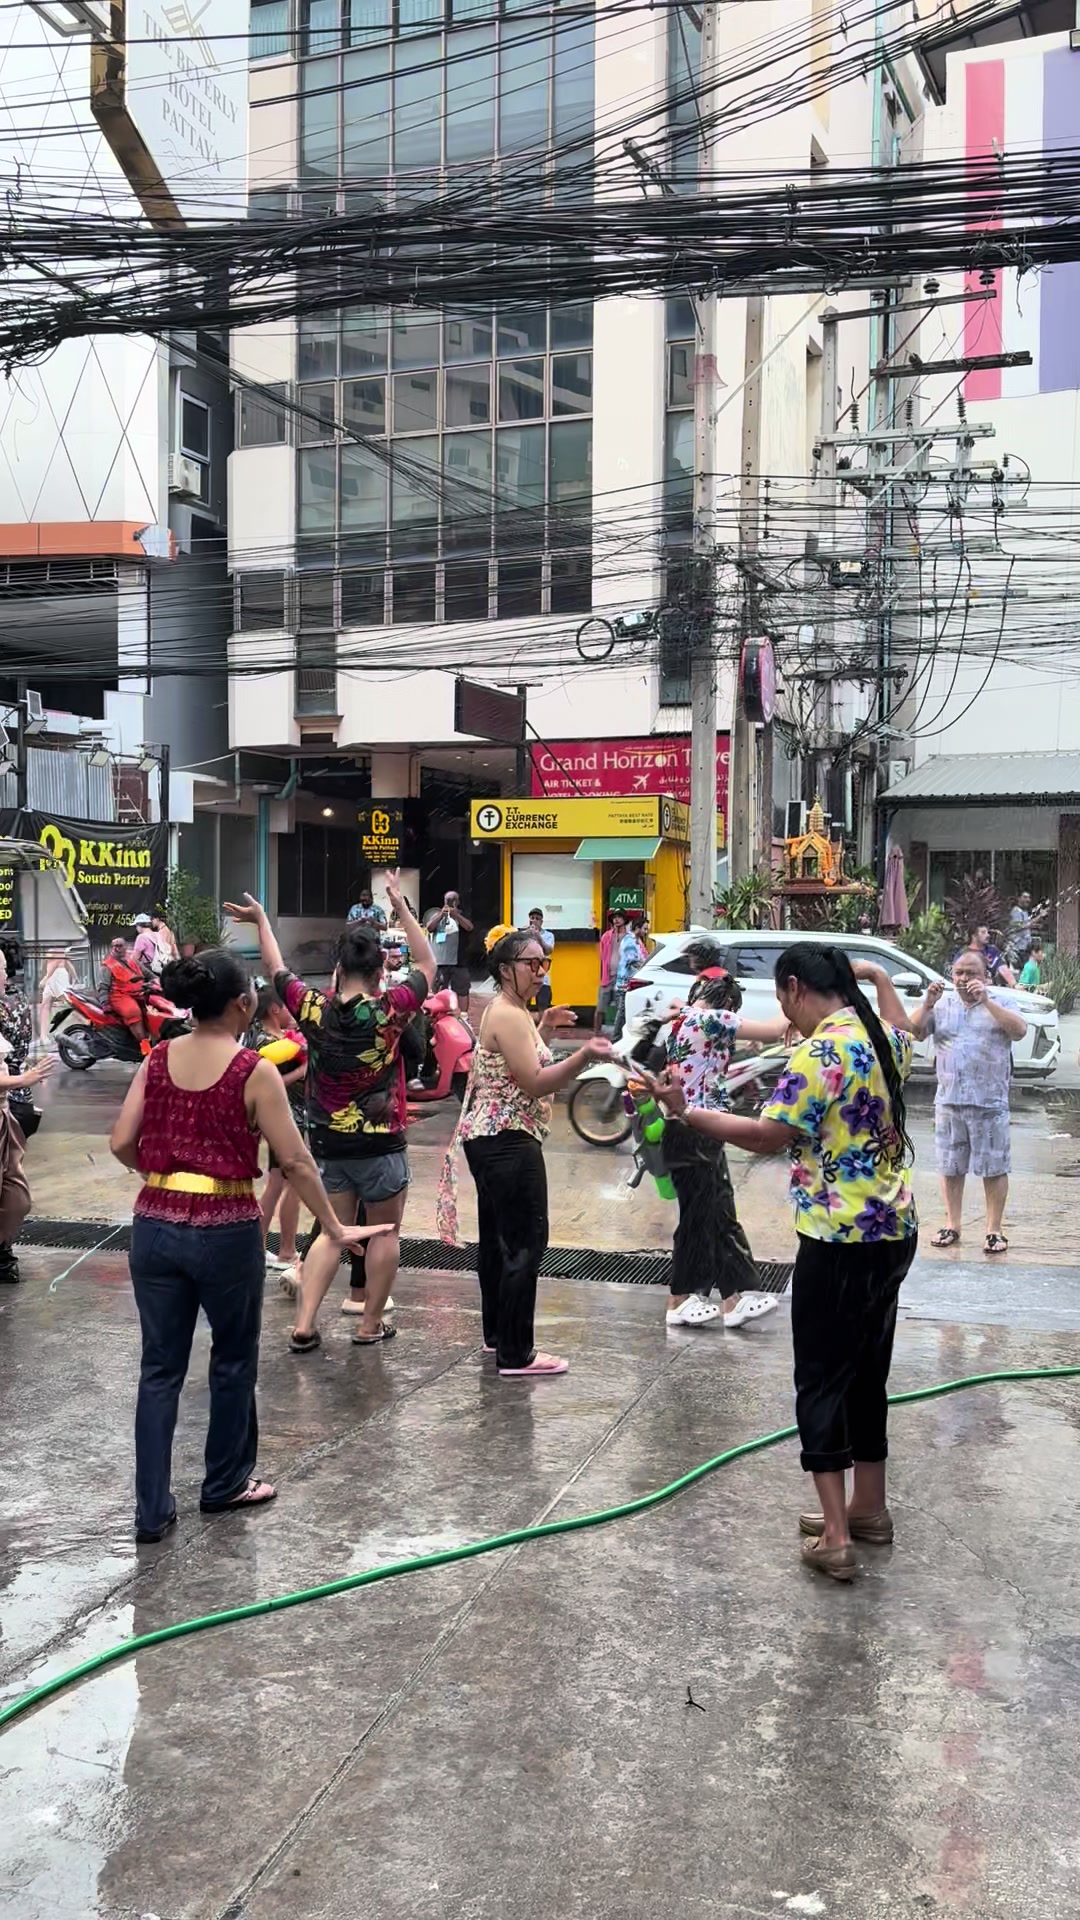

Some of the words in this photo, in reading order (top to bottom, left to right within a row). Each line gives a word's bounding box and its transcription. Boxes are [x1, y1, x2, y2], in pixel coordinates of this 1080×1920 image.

[143, 9, 172, 59] THE
[176, 45, 238, 124] BEVERLY
[168, 70, 216, 136] HOTEL
[162, 98, 221, 173] PATTAYA
[540, 753, 597, 771] Grand
[603, 751, 678, 769] Horizon
[544, 779, 559, 788] AIR
[561, 779, 592, 787] TICKET
[595, 778, 602, 787] &
[506, 806, 520, 814] T.T.
[505, 814, 558, 822] CURRENCY
[363, 835, 399, 845] KKinn
[79, 840, 151, 868] KKinn
[77, 870, 111, 885] South
[114, 873, 151, 887] Pattaya
[614, 893, 637, 904] ATM
[97, 913, 114, 926] 787
